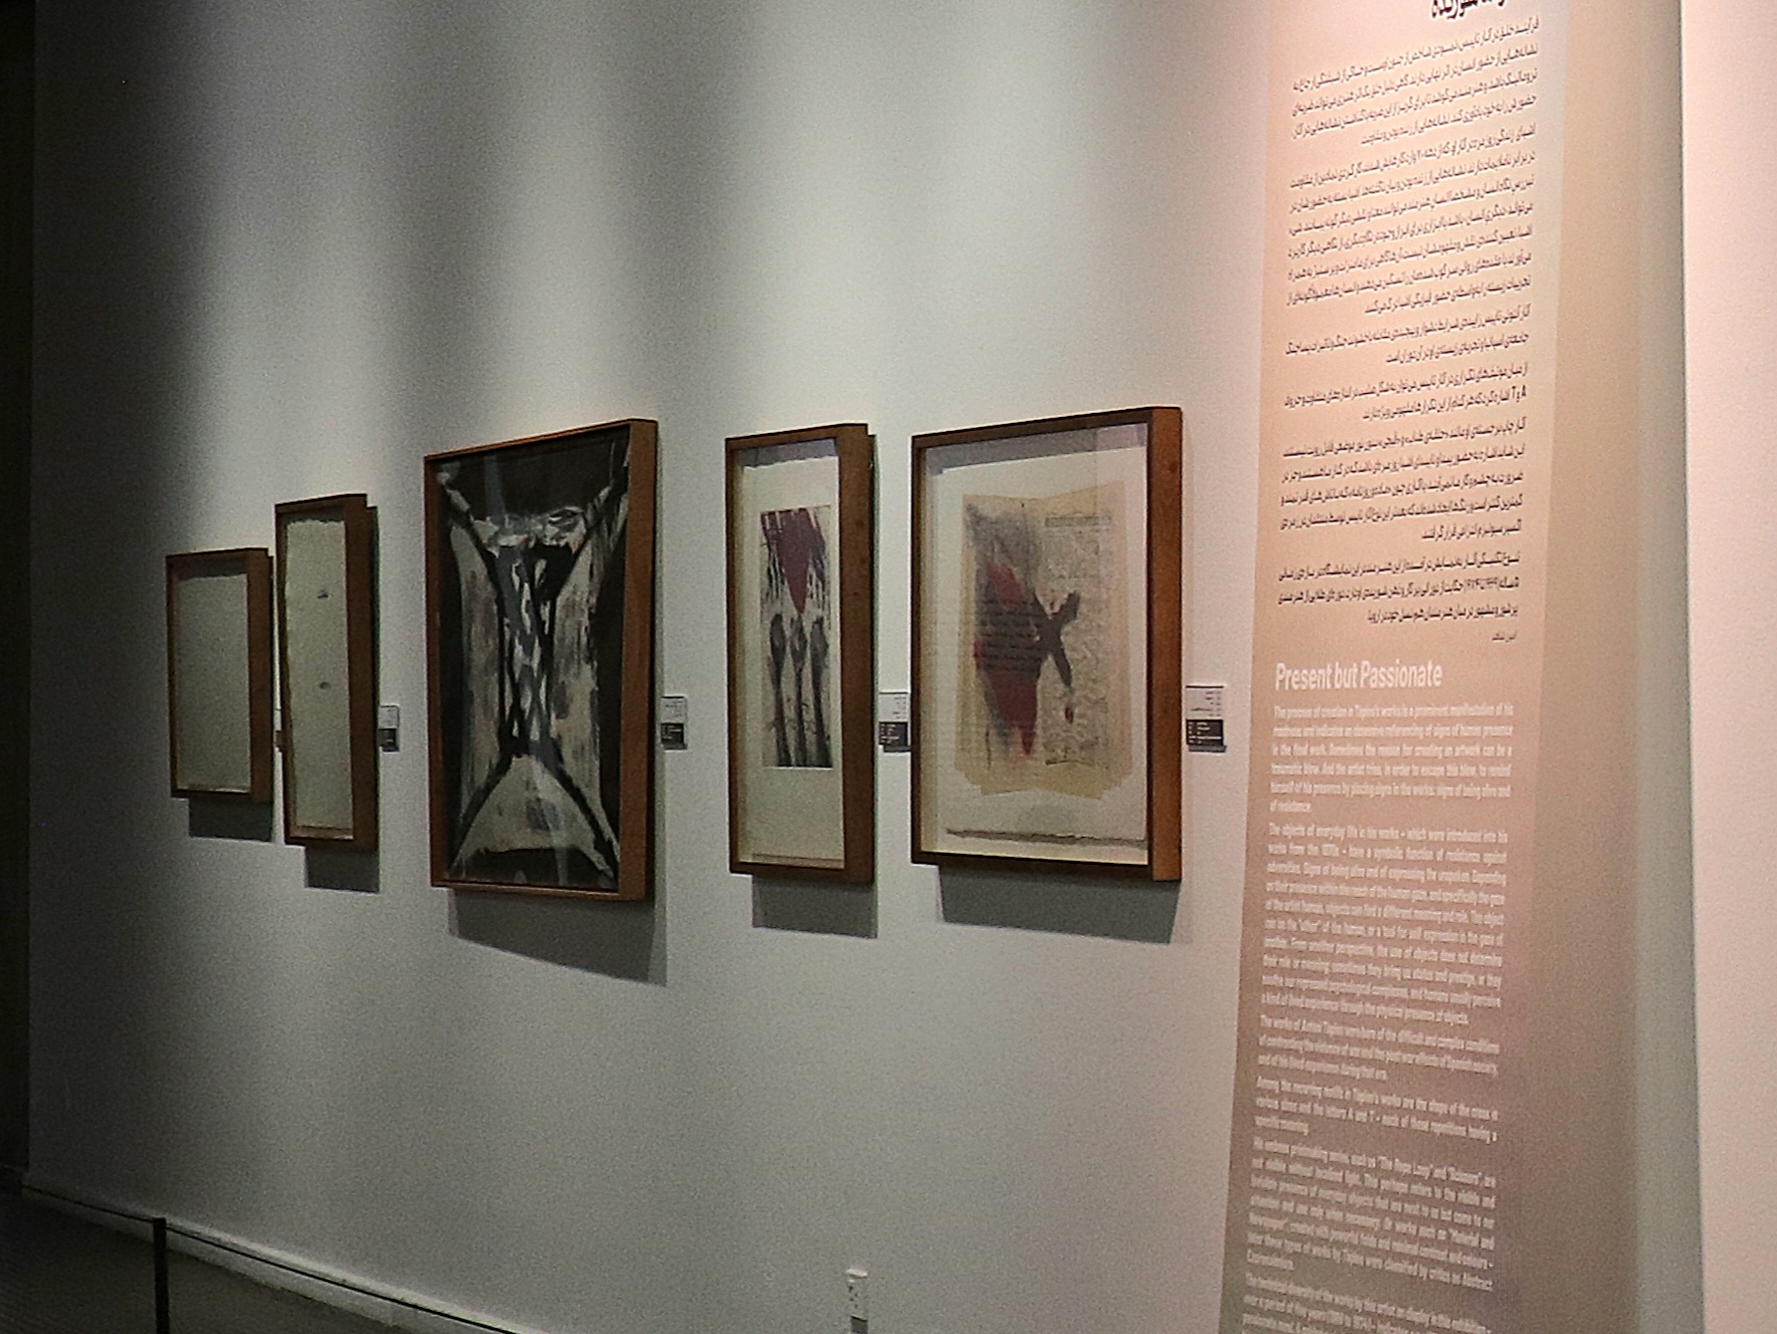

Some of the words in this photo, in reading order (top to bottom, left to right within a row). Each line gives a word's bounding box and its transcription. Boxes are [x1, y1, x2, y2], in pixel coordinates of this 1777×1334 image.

[1275, 662, 1331, 691] Present
[1334, 661, 1357, 689] but
[1359, 658, 1443, 689] Passionate
